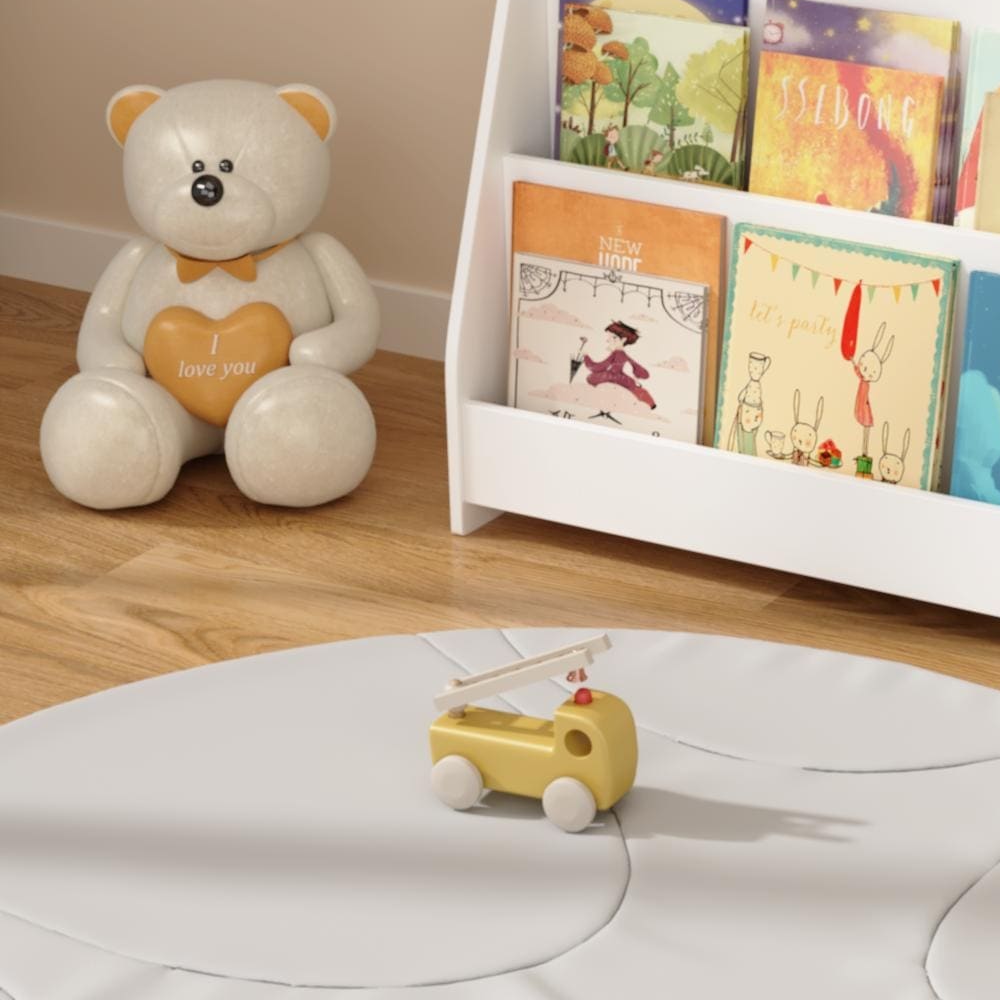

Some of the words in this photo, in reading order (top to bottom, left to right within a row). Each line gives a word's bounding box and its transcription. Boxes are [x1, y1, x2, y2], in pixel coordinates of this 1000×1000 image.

[774, 74, 916, 138] SSEBONG
[599, 235, 644, 255] NEW
[749, 299, 784, 328] let's
[786, 314, 837, 350] party
[210, 333, 219, 355] I
[178, 360, 217, 378] love
[219, 361, 256, 380] you
